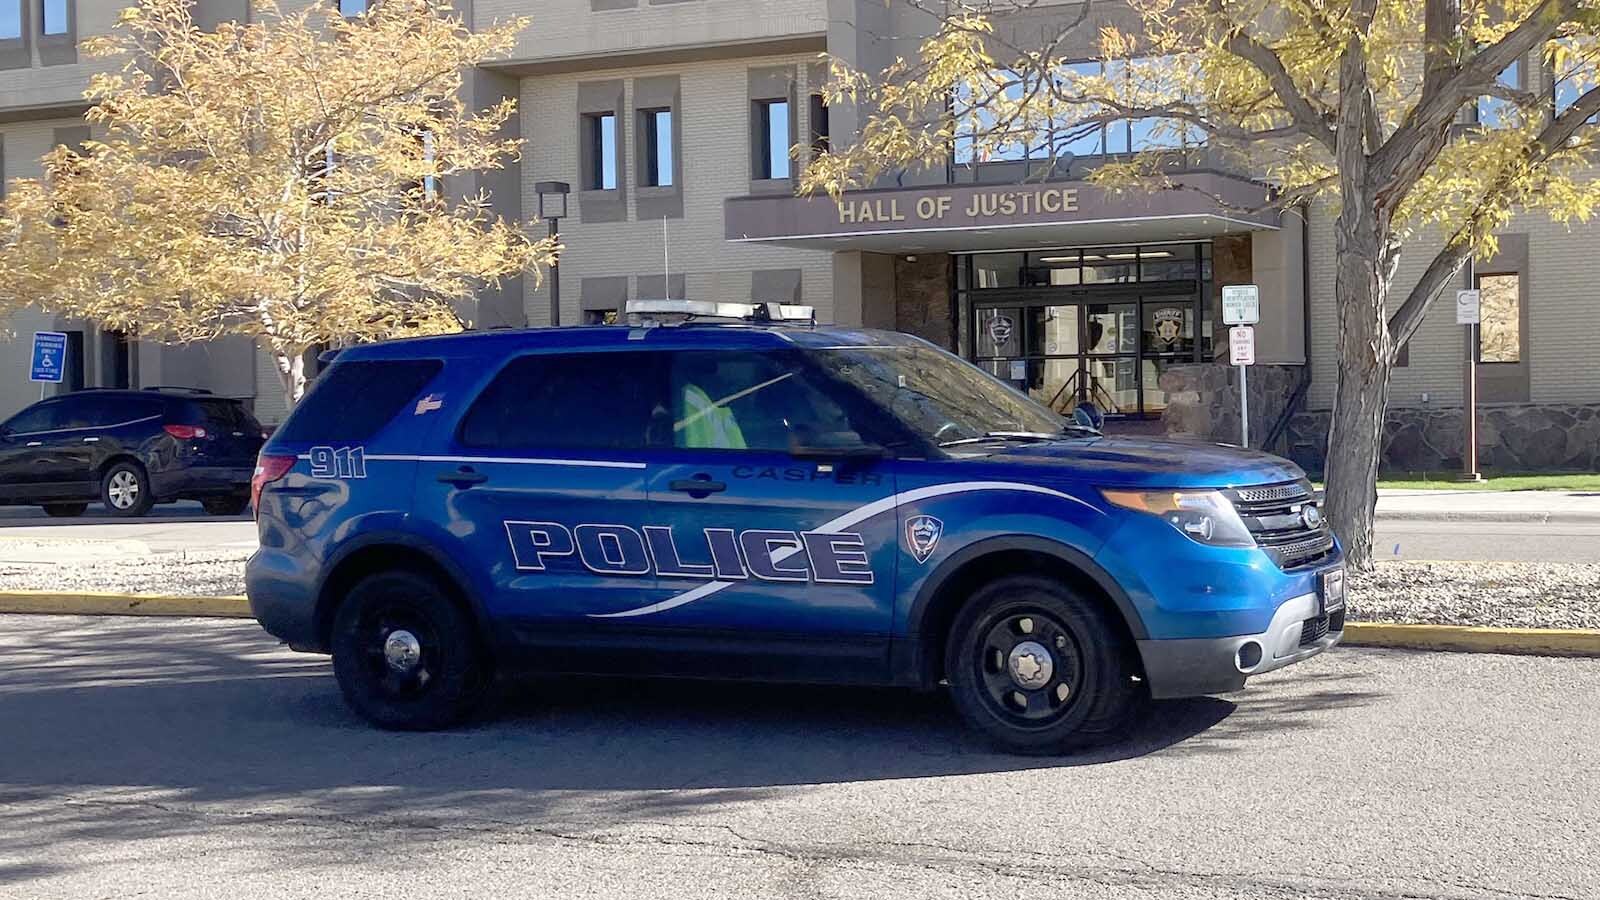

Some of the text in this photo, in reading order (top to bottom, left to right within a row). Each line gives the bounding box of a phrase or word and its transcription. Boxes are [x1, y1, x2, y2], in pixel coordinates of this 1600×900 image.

[838, 188, 1079, 224] HALL OF JUSTICE
[1236, 330, 1247, 338] NO
[309, 445, 367, 479] 911
[732, 464, 883, 487] CASPER
[503, 520, 874, 585] POLICE
